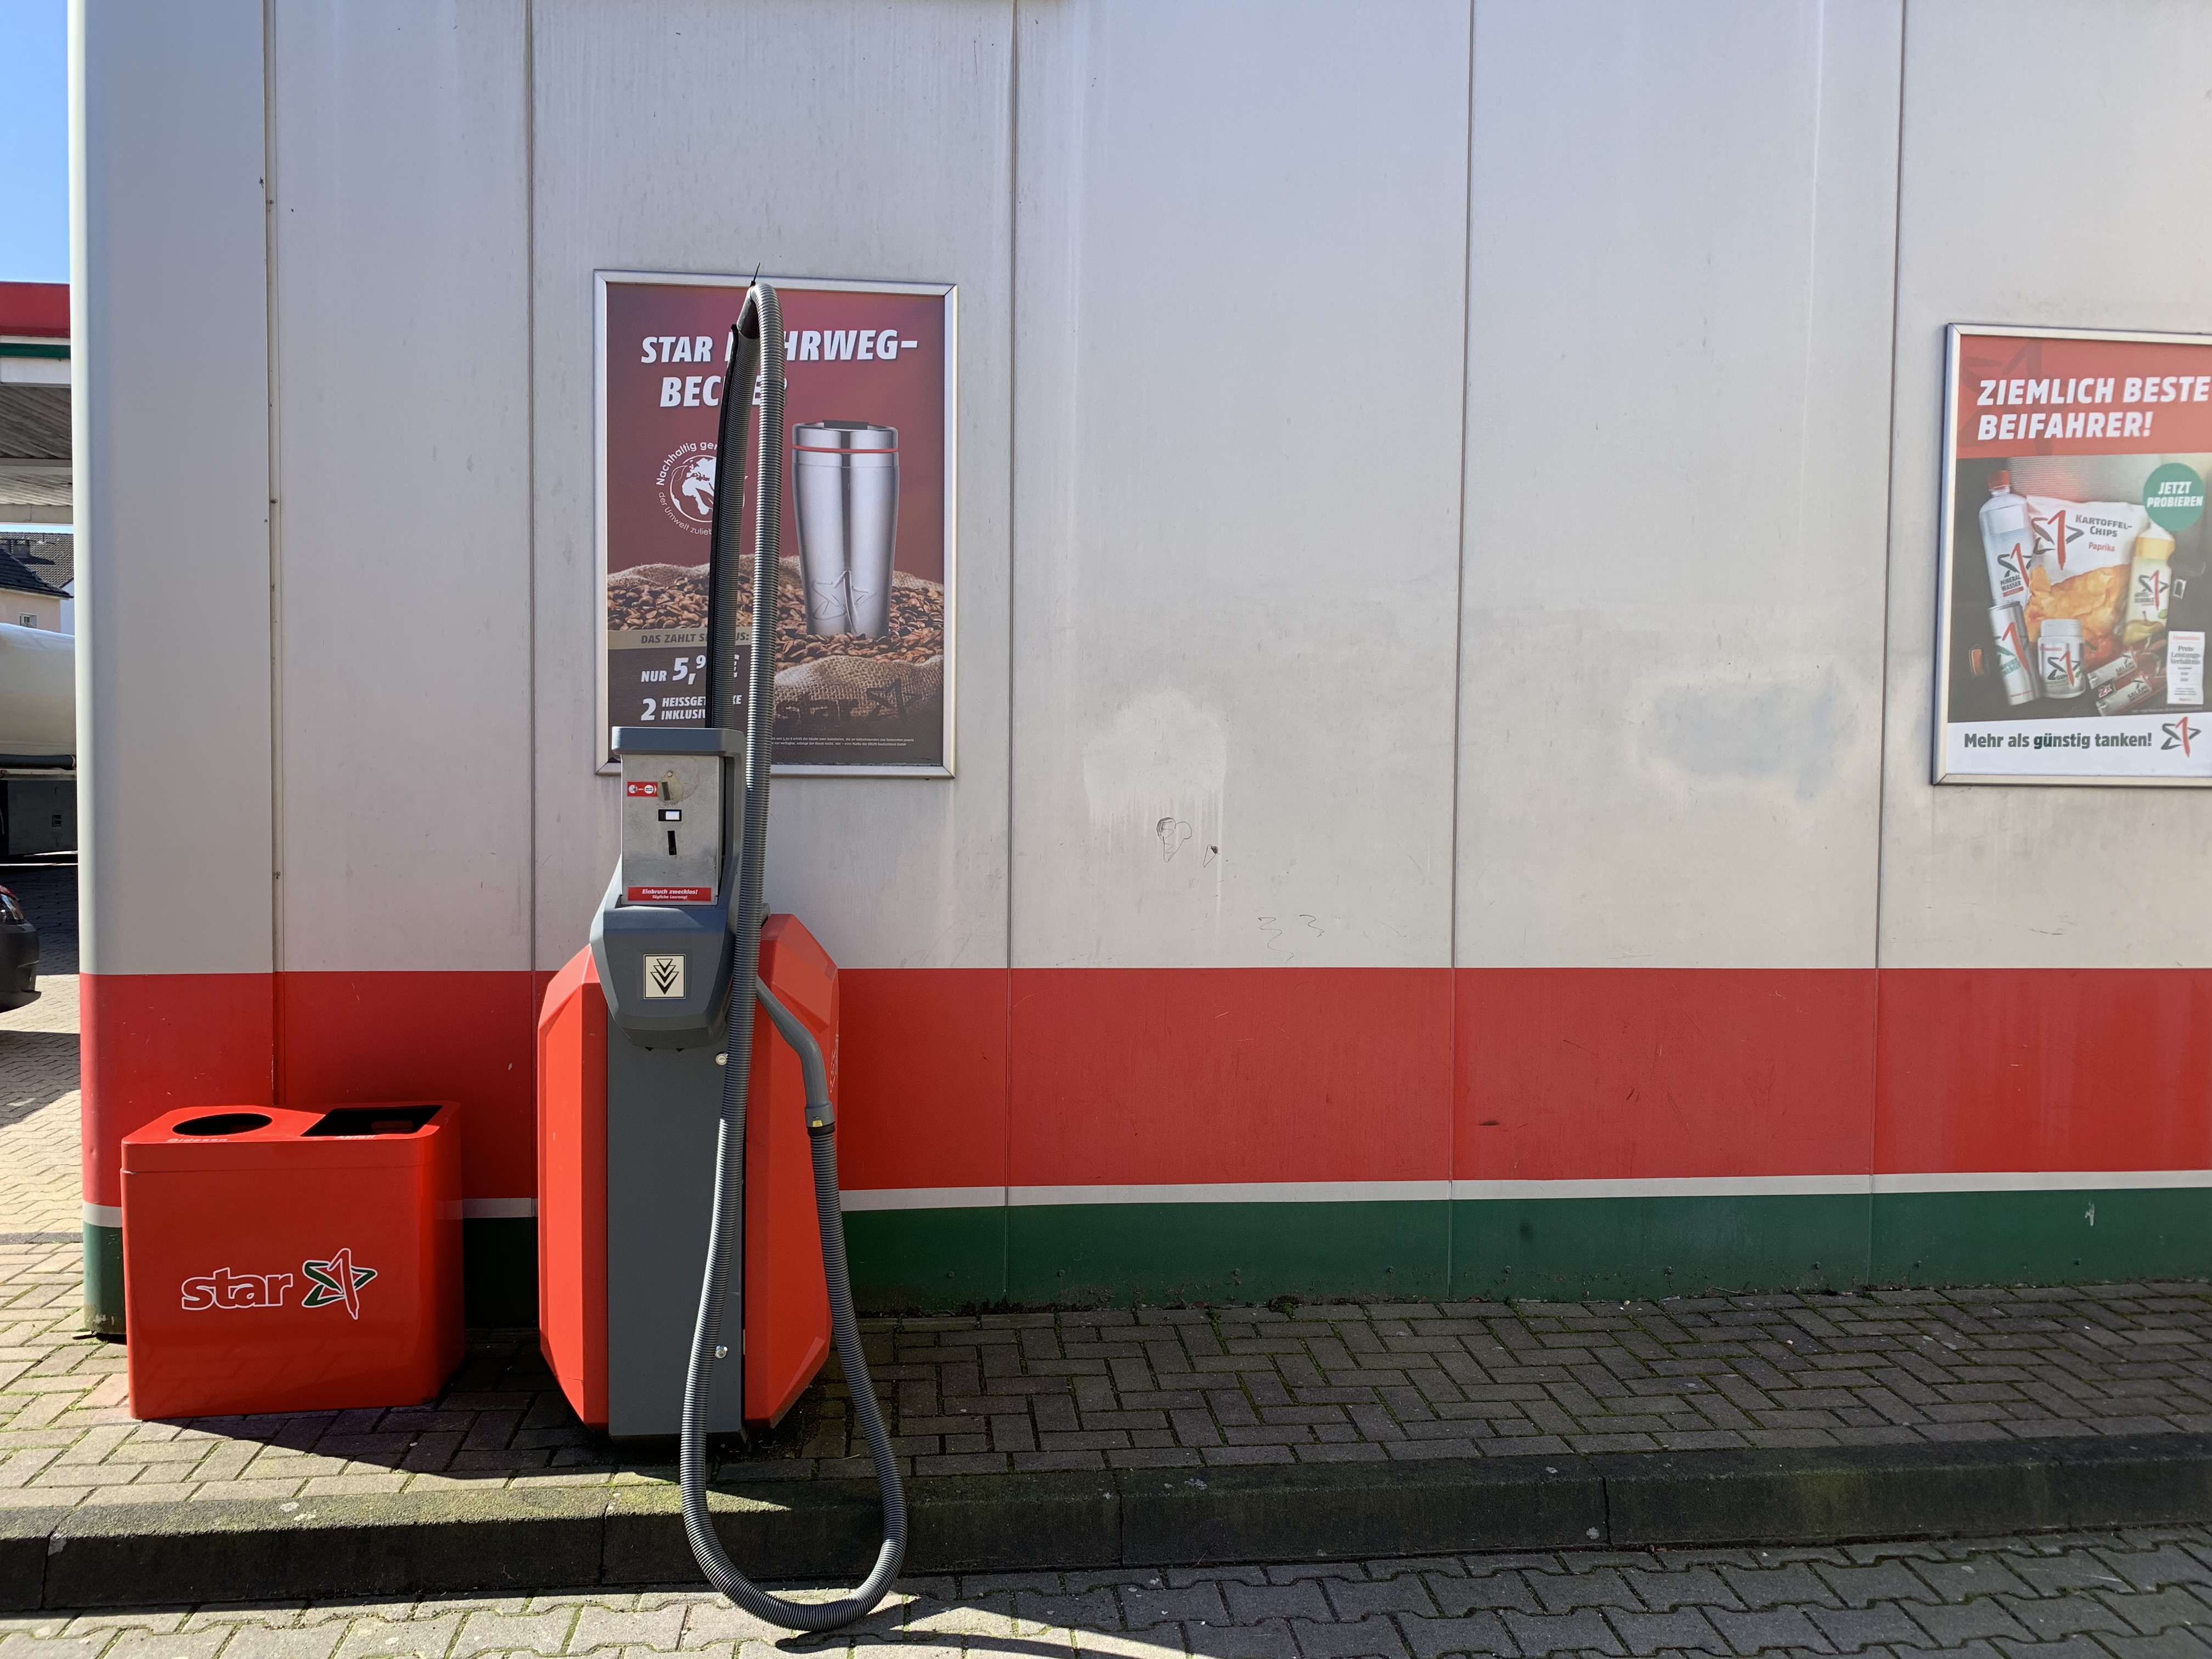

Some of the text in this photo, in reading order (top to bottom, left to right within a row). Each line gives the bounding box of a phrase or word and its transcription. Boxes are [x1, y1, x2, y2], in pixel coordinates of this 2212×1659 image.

[641, 329, 918, 363] STAR HRWEG-
[660, 375, 787, 407] BECE
[1977, 376, 2211, 406] ZIEMLICH BESTE
[1978, 411, 2153, 440] BEIFAHRER!
[656, 443, 697, 486] Nachhaltig
[2147, 496, 2204, 507] PROBIEREN
[2158, 481, 2192, 494] JETZT
[658, 492, 668, 505] der
[664, 505, 690, 531] Umwelt
[2089, 542, 2115, 552] Paprika
[2001, 580, 2022, 591] WASSER
[641, 635, 661, 644] DAS
[664, 634, 696, 643] ZAHLT
[641, 654, 707, 685] NUR 5,9
[641, 698, 657, 721] 2
[1965, 732, 2152, 750] Mehr als günstig tanken!
[181, 1267, 294, 1311] star
